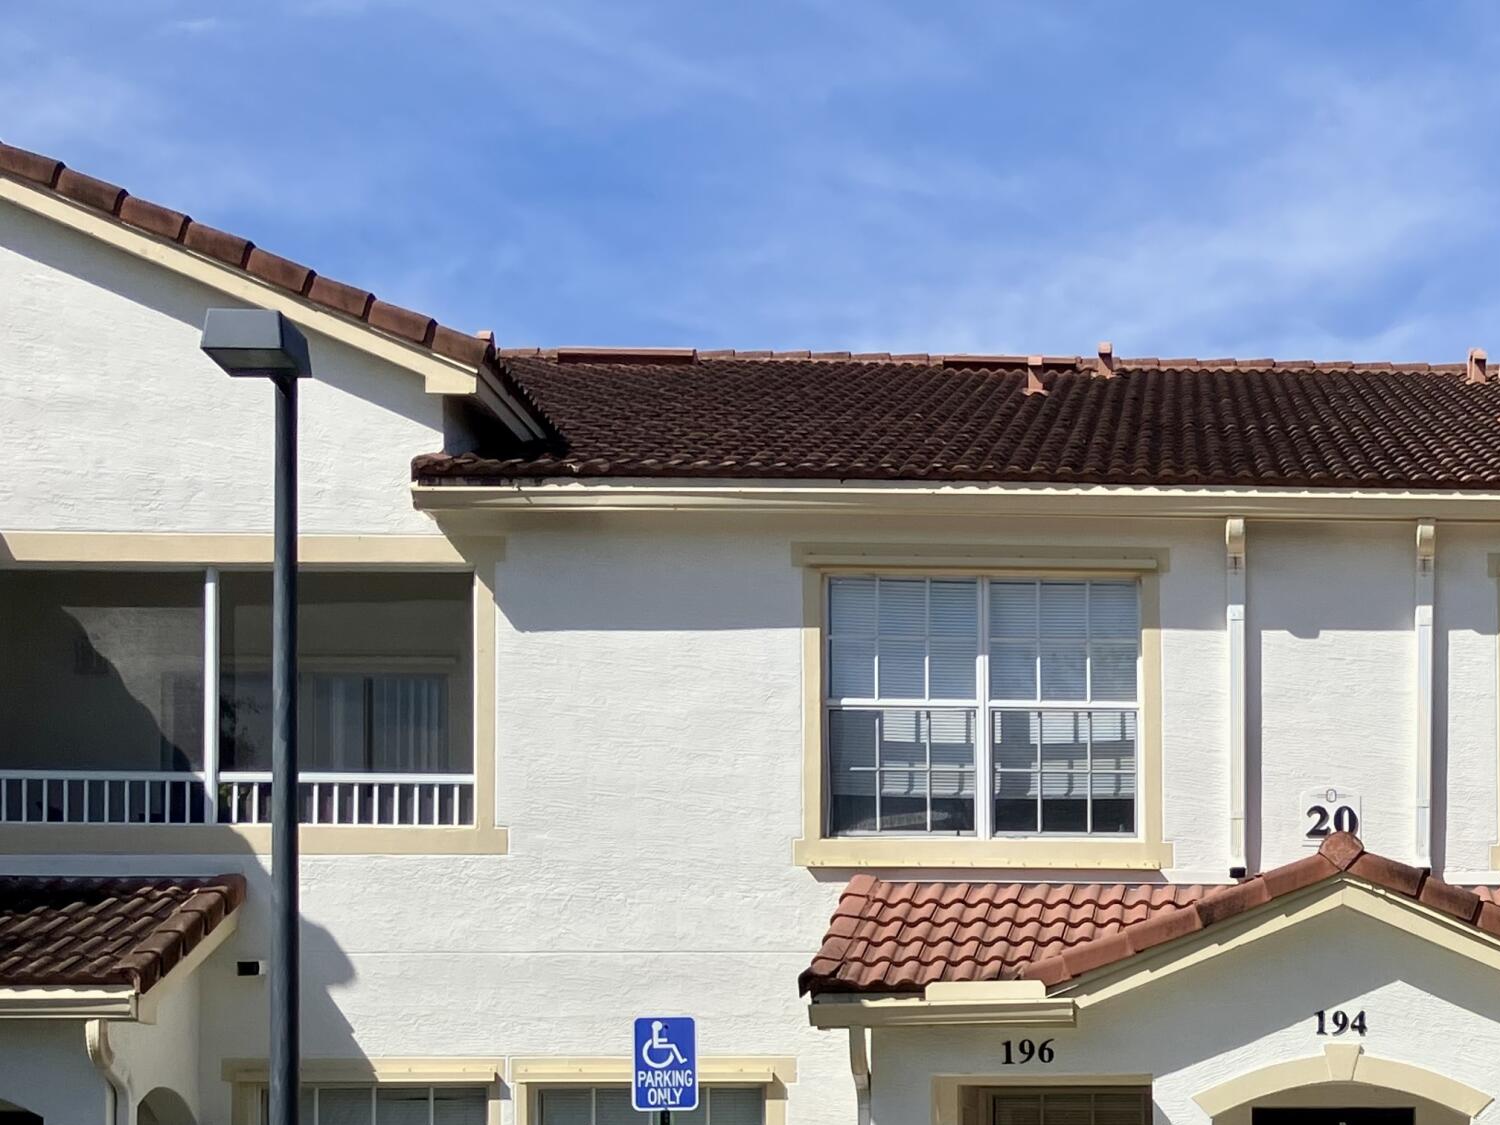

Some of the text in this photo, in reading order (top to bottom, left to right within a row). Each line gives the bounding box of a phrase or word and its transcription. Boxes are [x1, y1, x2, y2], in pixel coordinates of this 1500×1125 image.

[1306, 804, 1359, 839] 20
[1313, 1009, 1368, 1037] 194
[1001, 1038, 1055, 1065] 196
[637, 1069, 693, 1088] PARKING
[647, 1087, 683, 1106] ONLY
